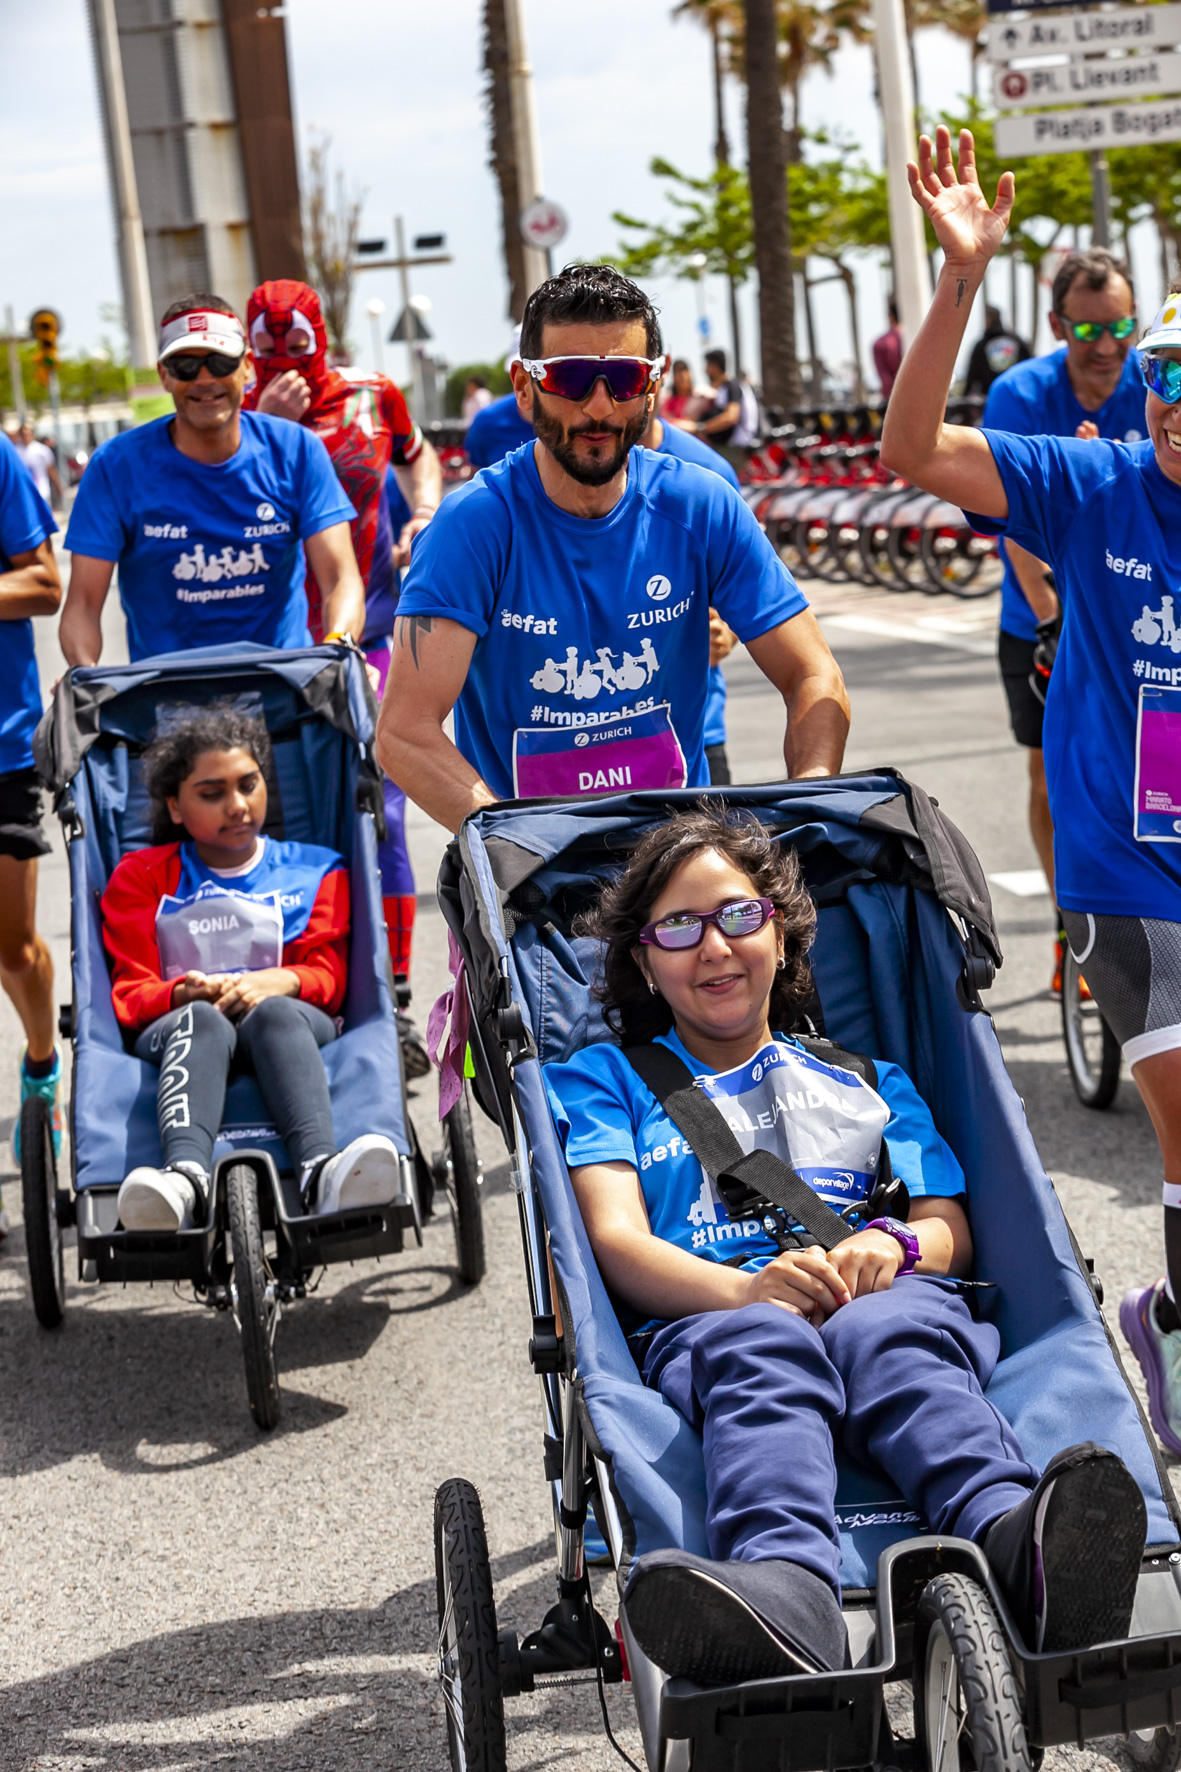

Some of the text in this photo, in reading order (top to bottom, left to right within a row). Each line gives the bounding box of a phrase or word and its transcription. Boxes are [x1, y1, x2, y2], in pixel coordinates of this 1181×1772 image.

[1030, 13, 1155, 47] Av. Litoral
[1031, 62, 1160, 93] Pl. Llevant
[1034, 115, 1105, 142] Platja
[144, 523, 188, 539] aefat
[243, 522, 291, 538] ZURICH
[1106, 551, 1153, 581] aefat
[176, 583, 265, 603] #Imparables
[501, 611, 558, 635] aefat
[627, 597, 691, 629] ZURICH
[591, 726, 632, 742] ZURICH
[578, 765, 632, 791] DANI
[188, 914, 240, 935] SONIA
